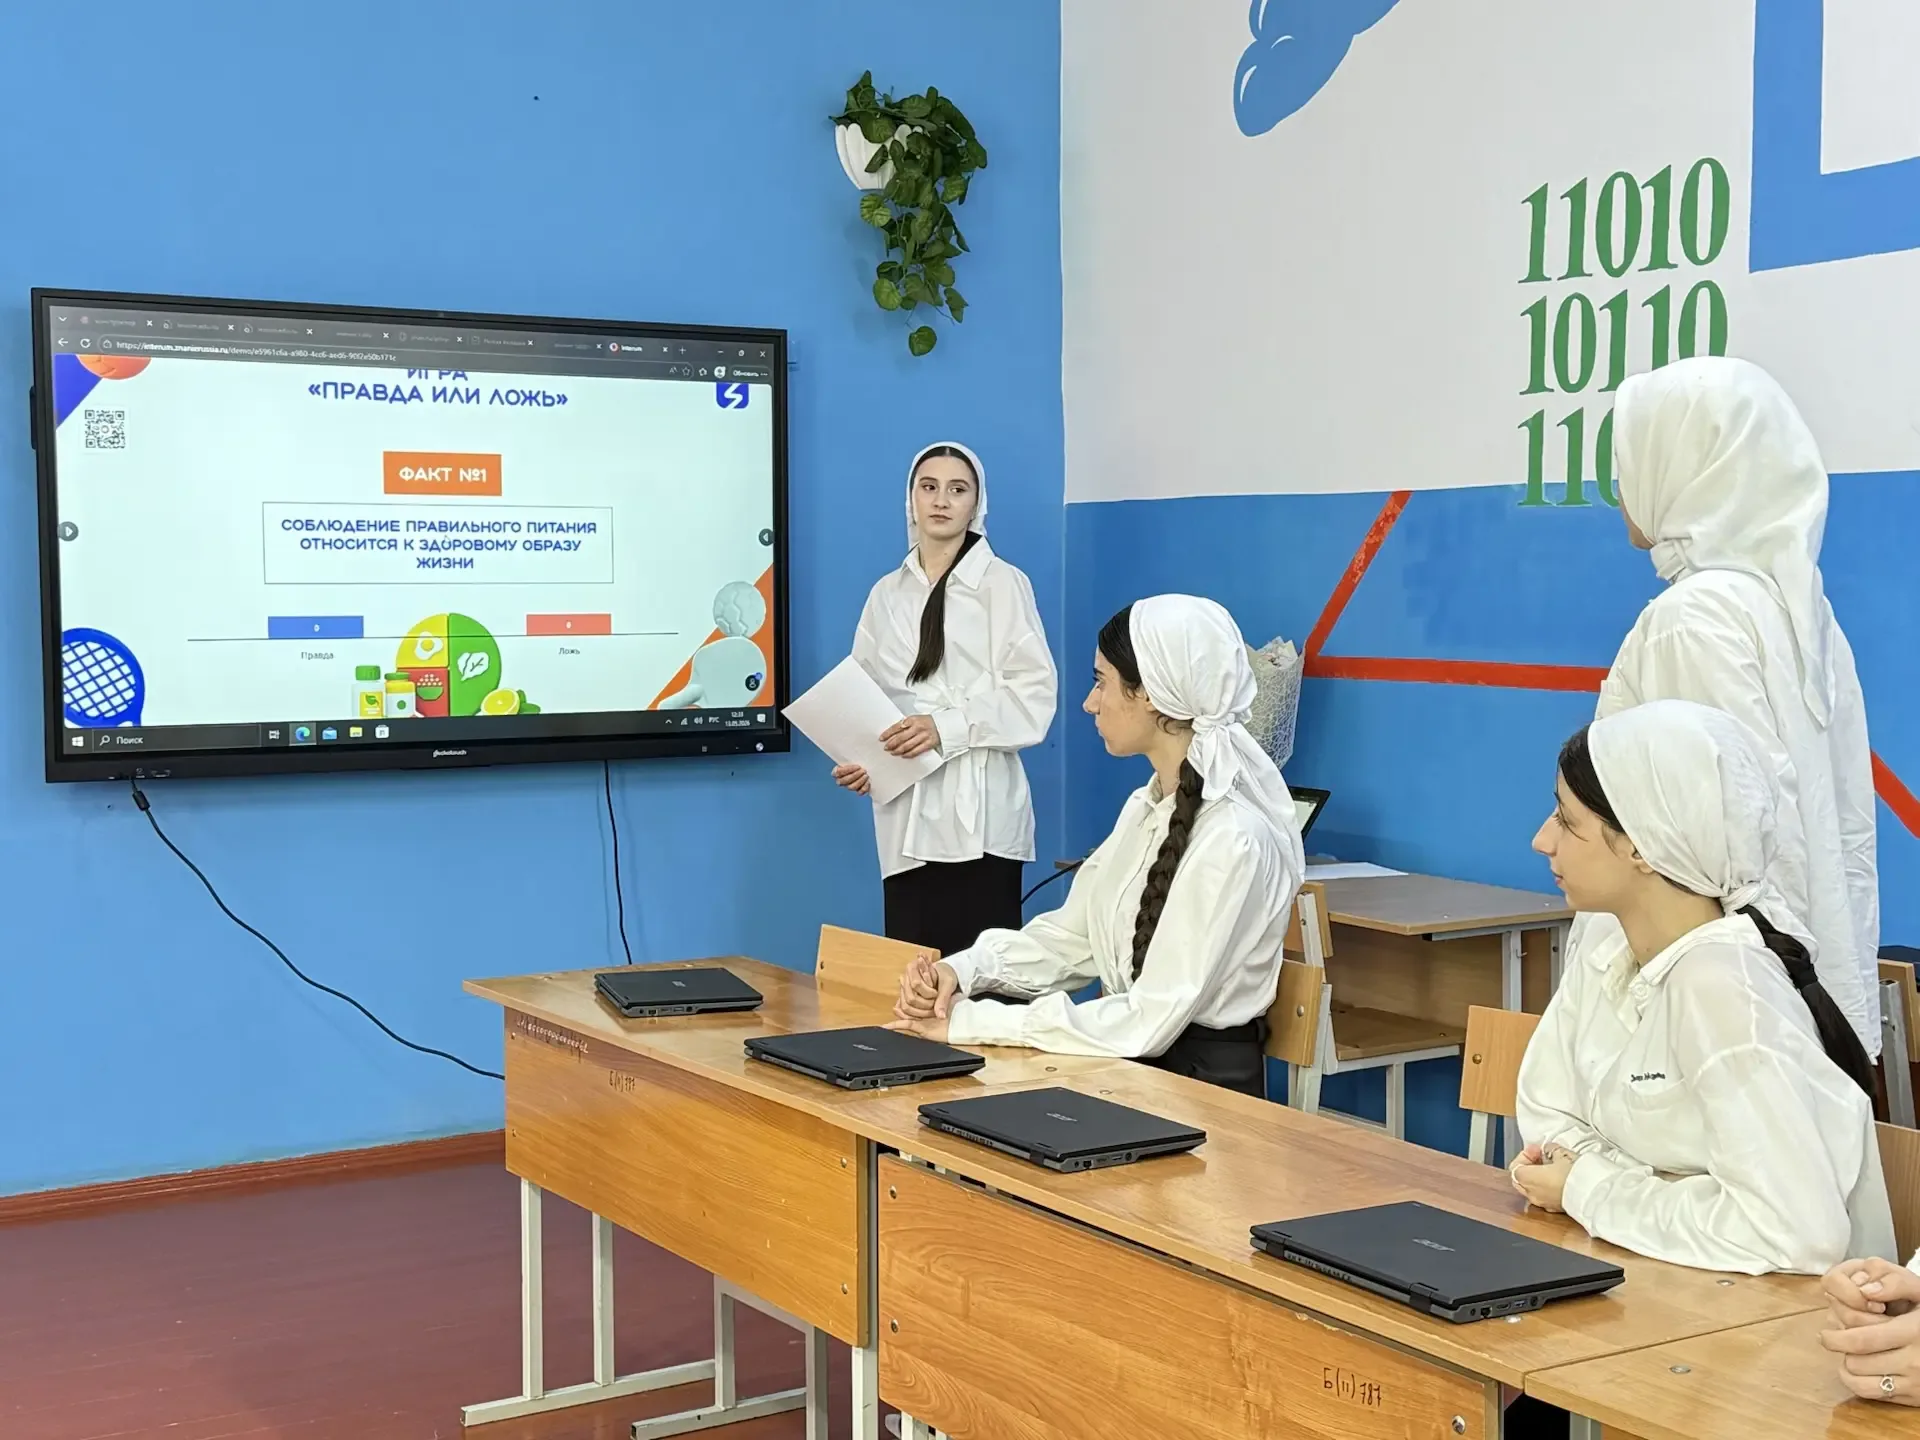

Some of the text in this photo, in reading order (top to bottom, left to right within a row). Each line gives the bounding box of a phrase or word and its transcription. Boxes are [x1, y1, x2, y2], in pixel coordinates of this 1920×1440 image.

[1517, 156, 1731, 284] 11010
[1519, 279, 1728, 395] 10110
[308, 381, 568, 407] «ПРАВДА ИЛИ ЛОЖЬ»
[399, 466, 487, 483] ФАКТ №1
[281, 519, 597, 534] СОБЛЮДЕНИЕ ПРАВИЛЬНОГО ПИТАНИЯ
[300, 537, 582, 552] ОТНОСИТСЯ К ЗДОРОВОМУ ОБРАЗУ
[416, 556, 475, 569] ЖИЗНИ
[313, 623, 320, 632] 0
[301, 651, 334, 660] Правда
[558, 647, 581, 655] Ложь
[116, 735, 143, 745] Поиск
